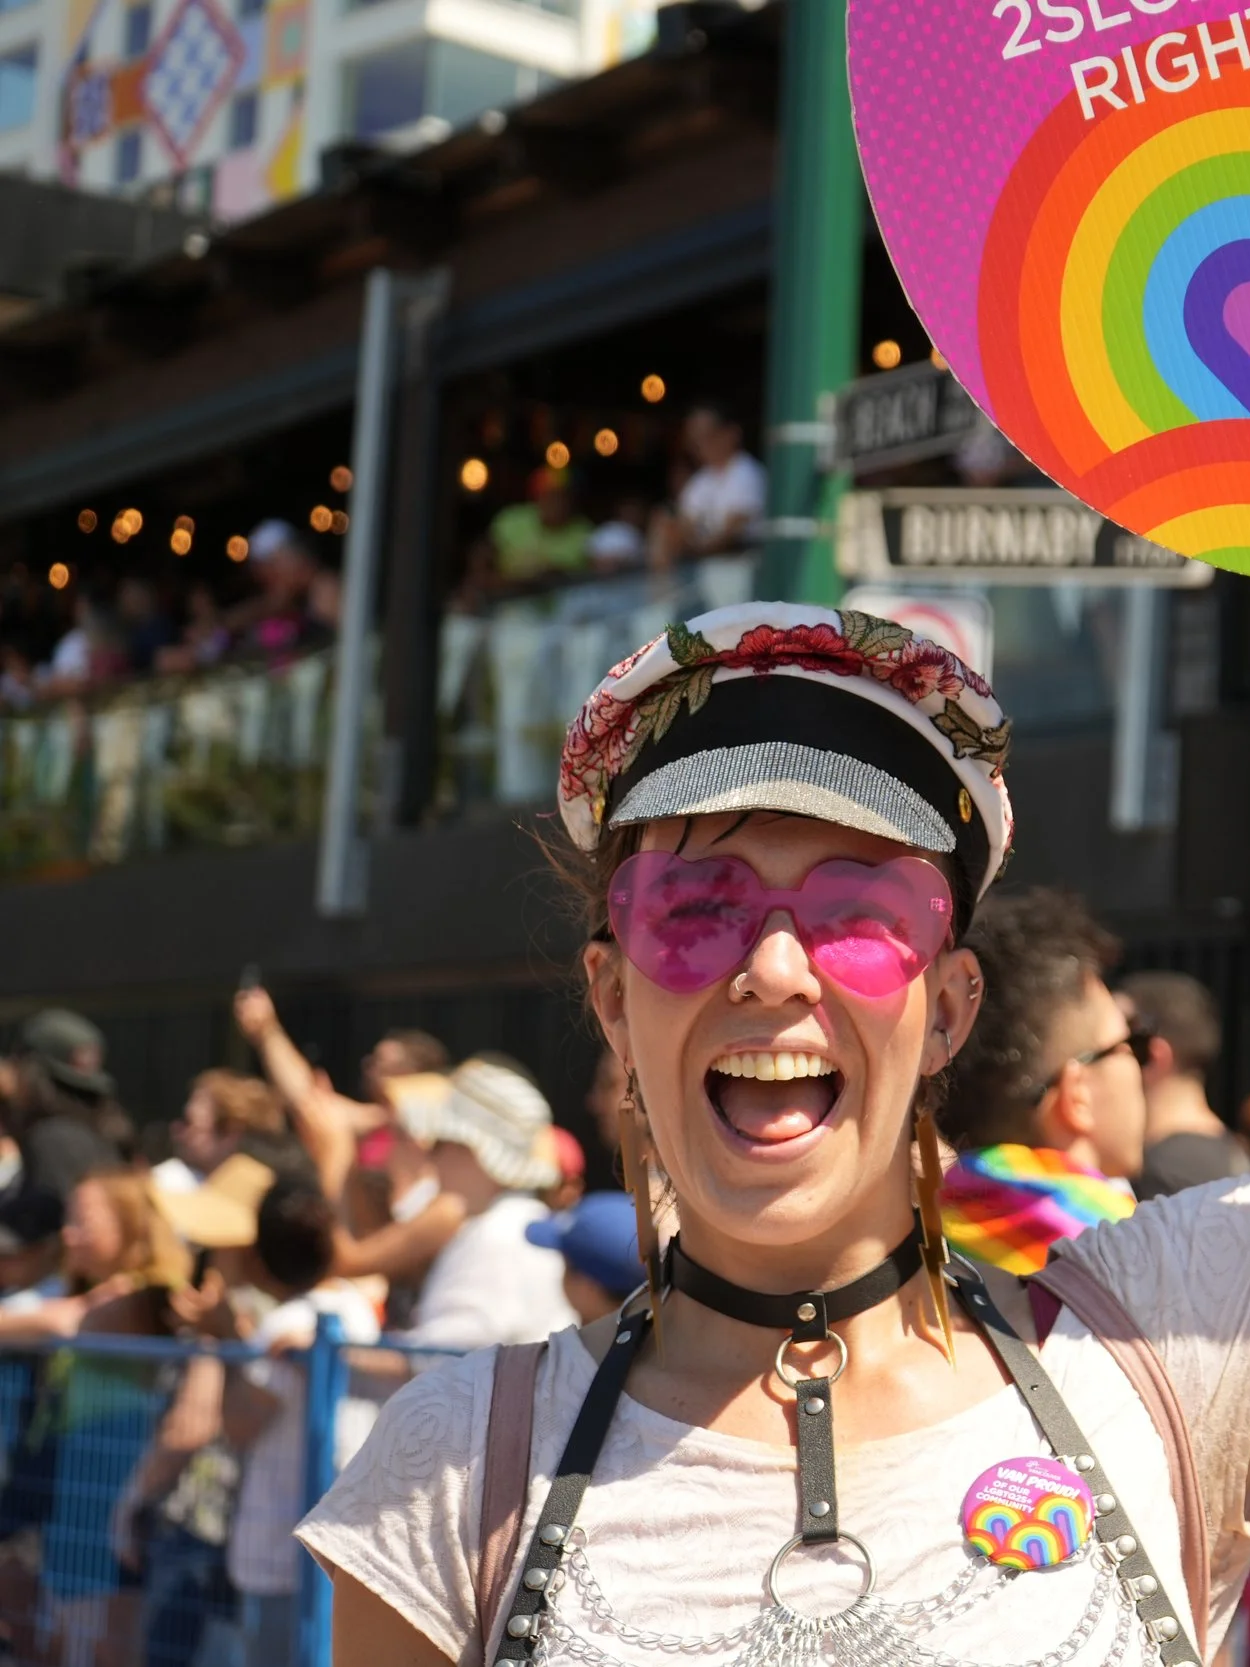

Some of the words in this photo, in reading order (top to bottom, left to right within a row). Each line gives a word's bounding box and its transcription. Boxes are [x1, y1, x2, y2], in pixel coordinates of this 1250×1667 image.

[901, 504, 1103, 566] BURNABY
[993, 1480, 1008, 1490] OF
[1008, 1484, 1030, 1496] OUR
[997, 1467, 1026, 1484] VAN
[1026, 1475, 1081, 1499] PROUD!
[976, 1492, 1035, 1514] COMMUNITY
